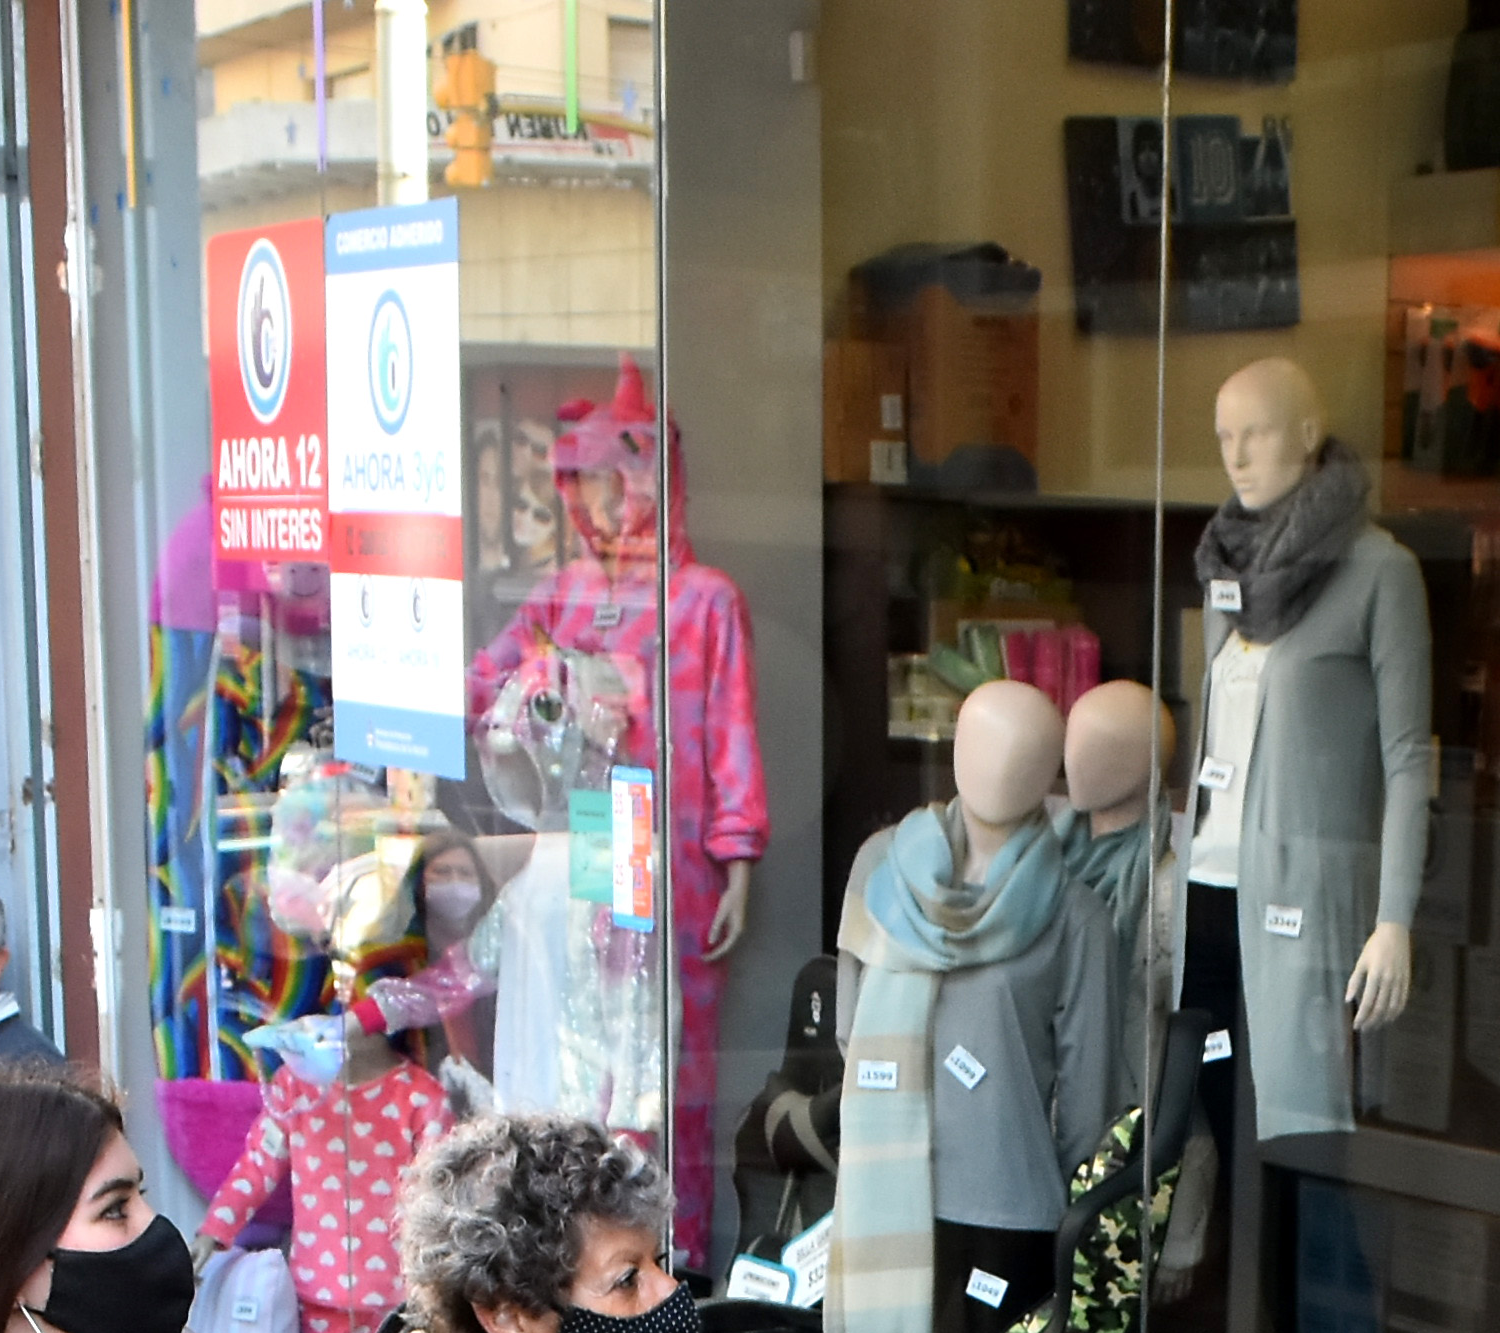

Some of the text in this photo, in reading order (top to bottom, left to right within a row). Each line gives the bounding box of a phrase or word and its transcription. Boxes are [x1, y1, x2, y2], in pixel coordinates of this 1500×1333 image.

[219, 434, 322, 489] AHORA 12
[343, 450, 445, 502] AHORA 3y6
[220, 509, 248, 548] SIN
[251, 507, 322, 550] INTERES
